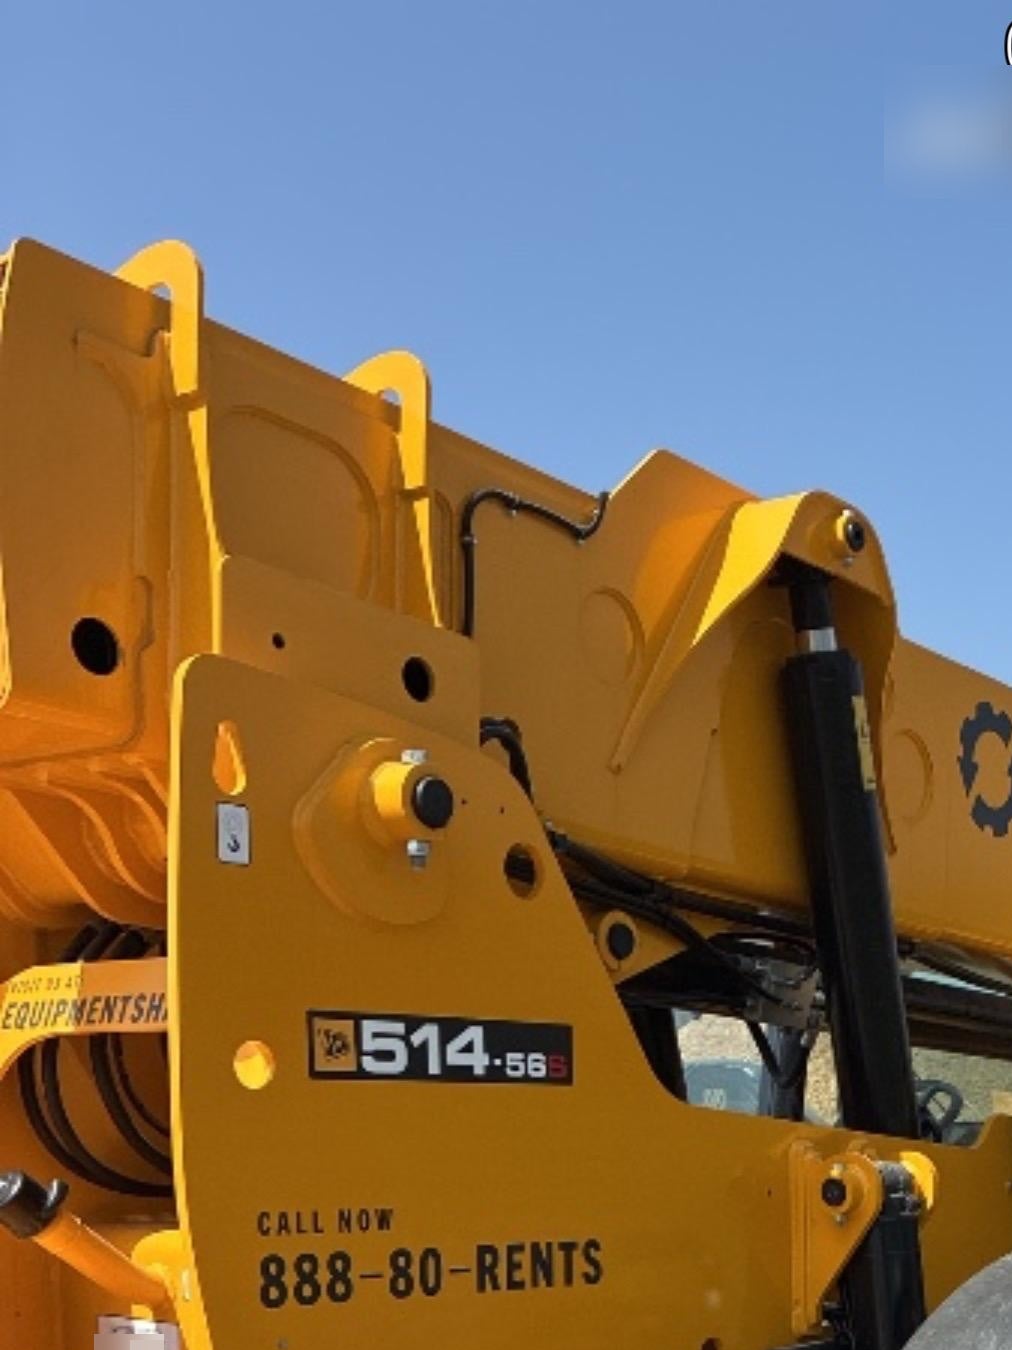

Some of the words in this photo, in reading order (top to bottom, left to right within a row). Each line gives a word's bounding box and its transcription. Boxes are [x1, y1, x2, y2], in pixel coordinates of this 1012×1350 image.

[2, 992, 168, 1030] EQUIPMENTSH
[257, 1210, 325, 1236] CALL
[337, 1208, 394, 1232] NOW
[260, 1239, 603, 1309] 888-80-RENTS
